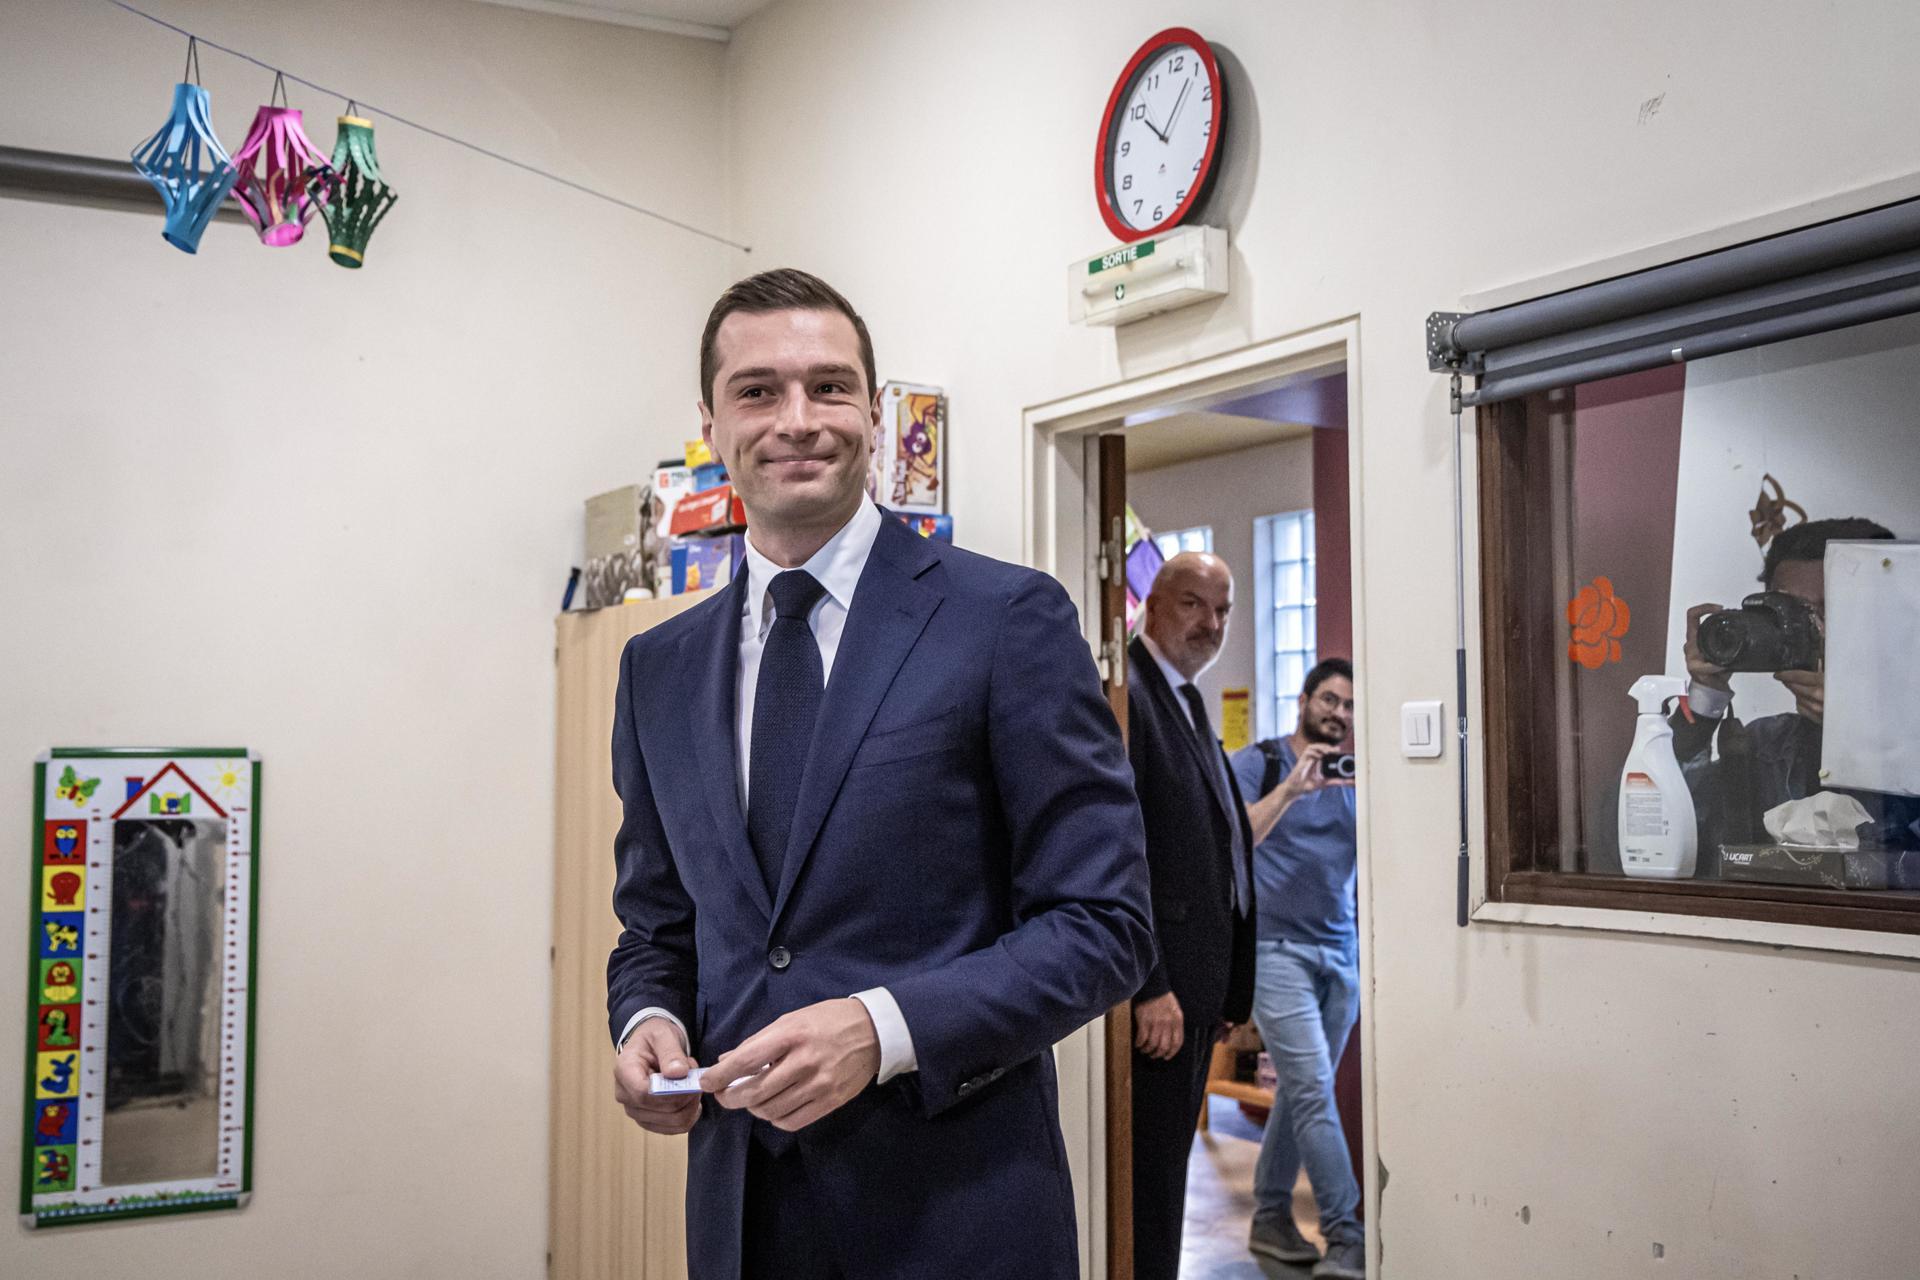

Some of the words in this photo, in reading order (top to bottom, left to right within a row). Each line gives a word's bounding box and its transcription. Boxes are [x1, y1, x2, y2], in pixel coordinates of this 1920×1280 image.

[1168, 56, 1184, 74] 12
[1194, 62, 1199, 77] 1
[1147, 74, 1159, 91] 11
[1202, 85, 1212, 102] 2
[1130, 104, 1146, 122] 10
[1121, 141, 1131, 157] 9
[1122, 175, 1132, 191] 8
[1175, 190, 1185, 206] 5
[1133, 199, 1143, 216] 7
[1153, 205, 1163, 221] 6
[1102, 247, 1137, 270] SORTIE
